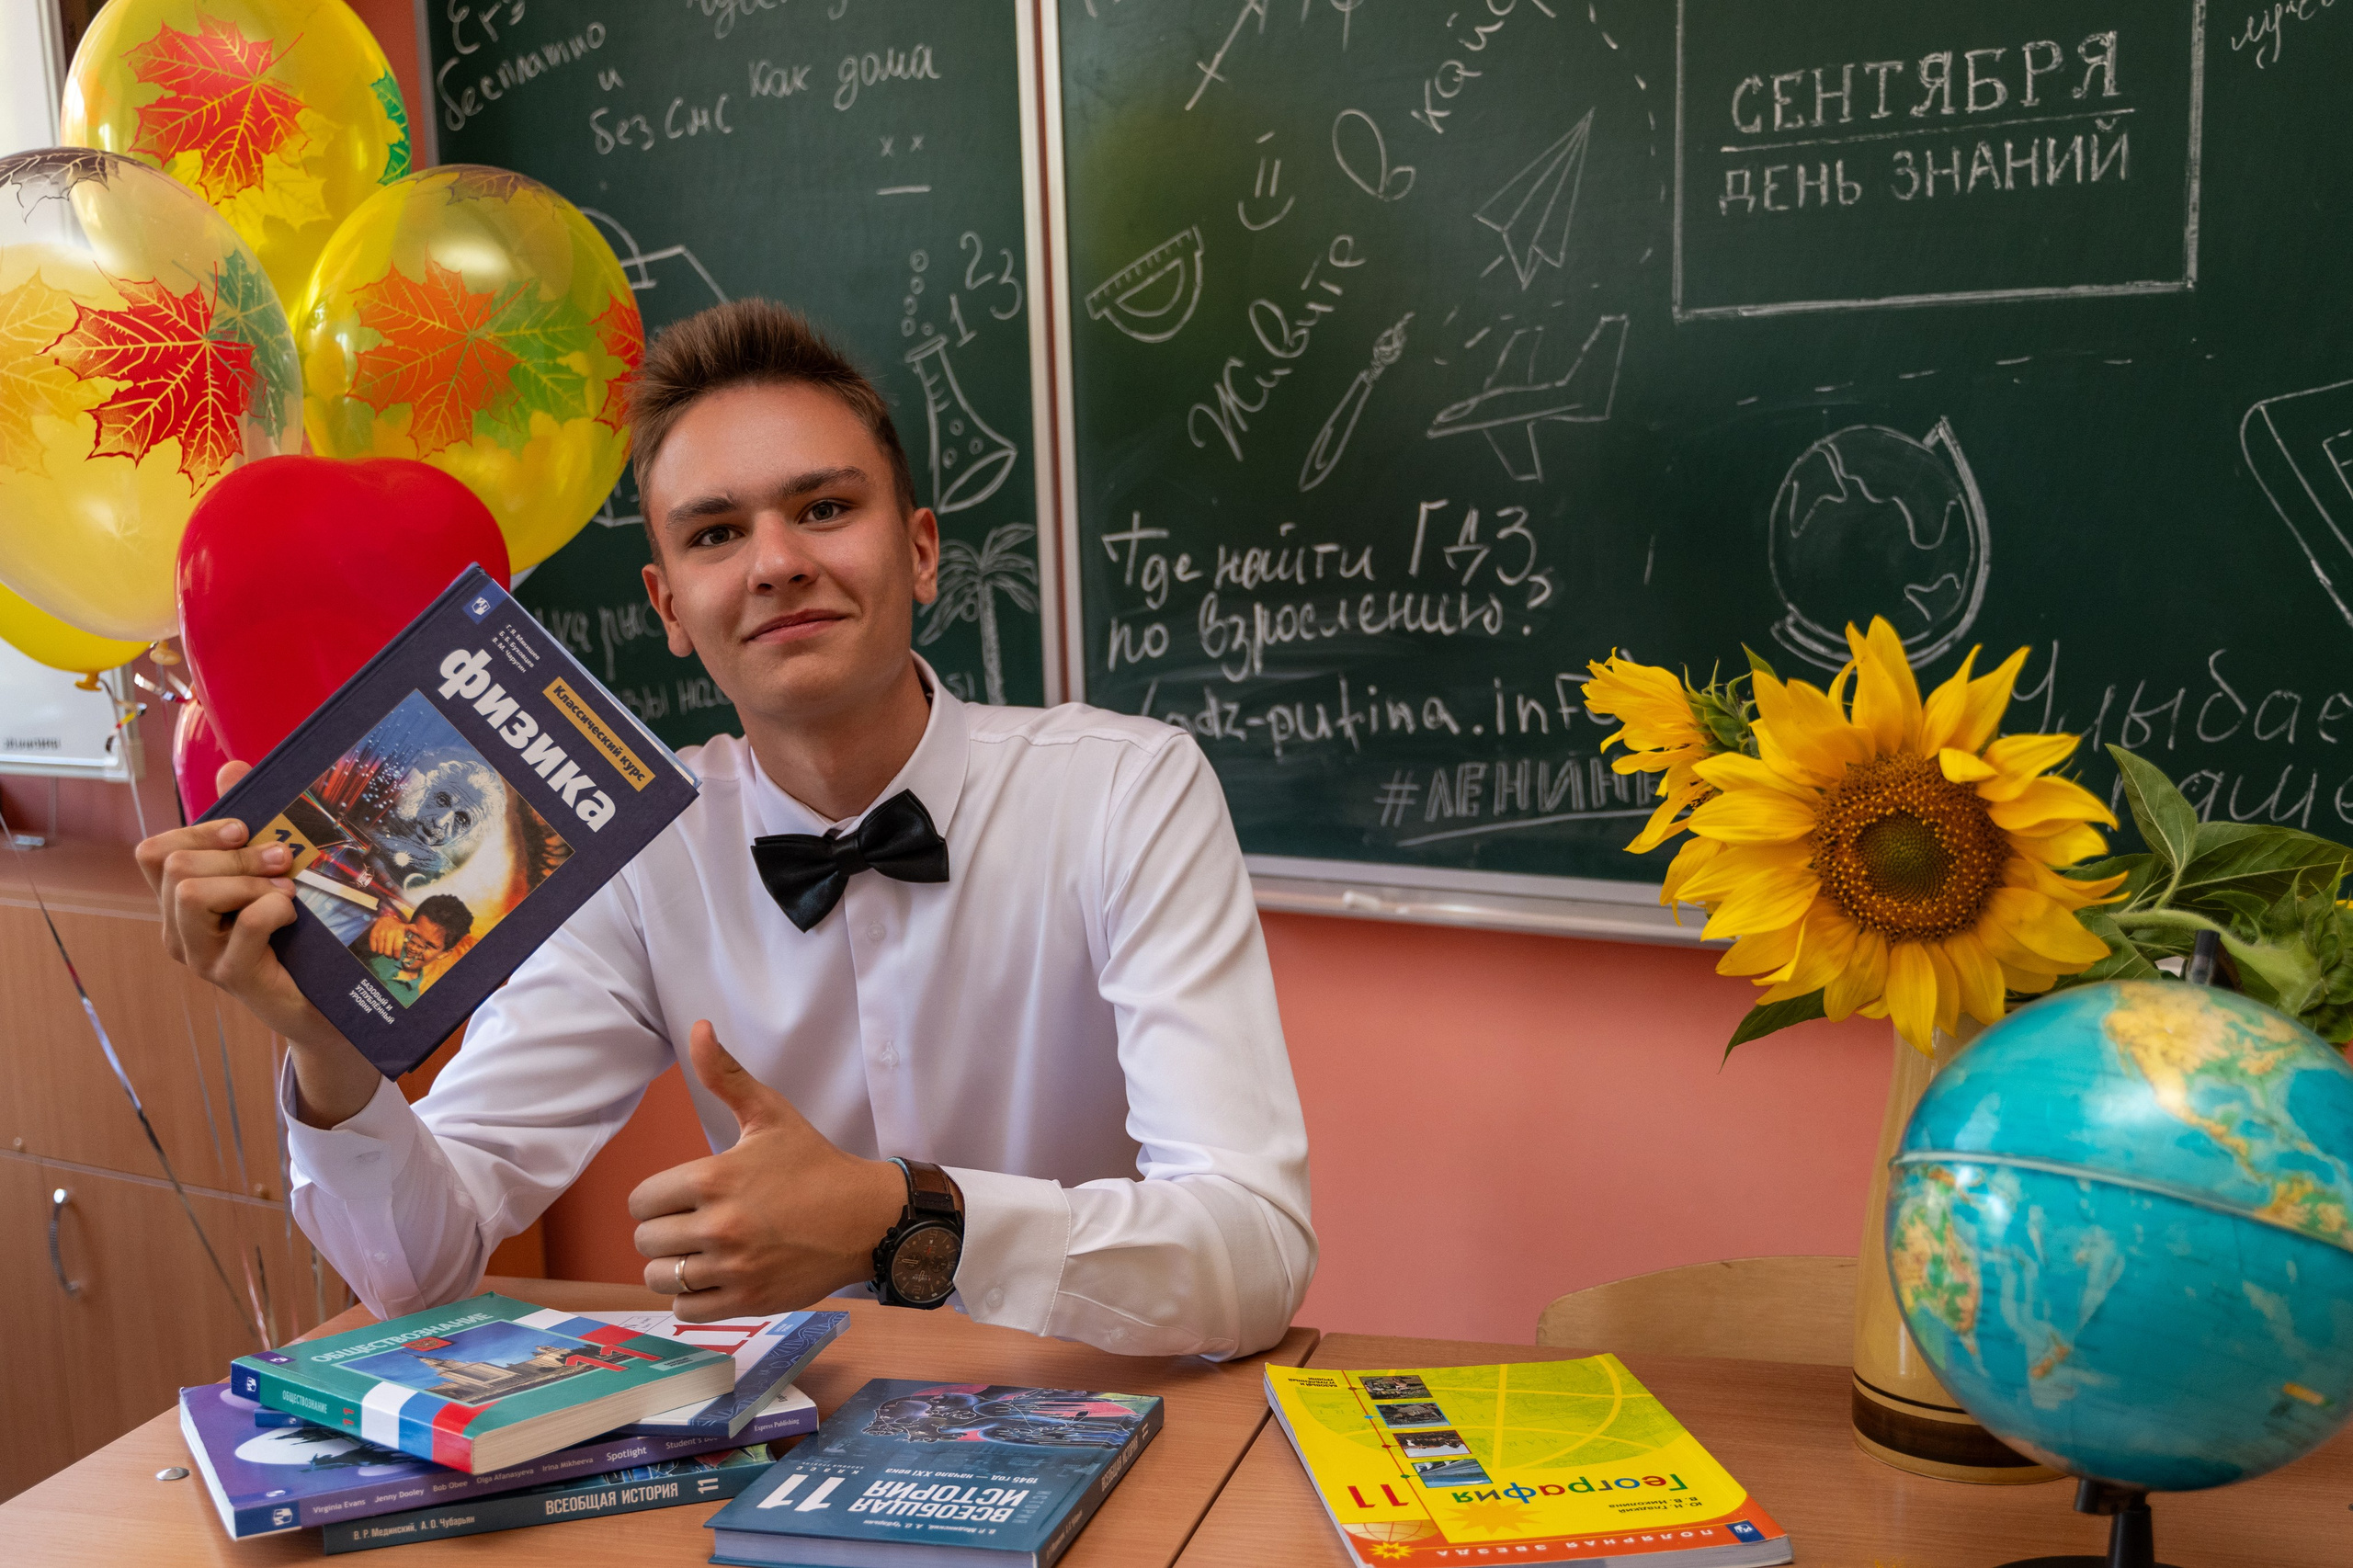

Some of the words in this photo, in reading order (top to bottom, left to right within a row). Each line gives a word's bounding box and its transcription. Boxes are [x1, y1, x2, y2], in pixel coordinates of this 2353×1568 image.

[597, 66, 625, 91] и
[834, 42, 942, 111] дома
[1731, 30, 2121, 134] СЕНТЯБРЯ
[589, 107, 655, 154] без
[1719, 158, 1864, 216] ДЕНЬ
[1891, 118, 2131, 201] ЗНАНИЙ
[1215, 522, 1376, 589] найти
[509, 642, 535, 668] Буховцев
[1108, 617, 1170, 671] по
[506, 649, 527, 673] Чаругин
[552, 685, 624, 758] Классический
[620, 753, 646, 782] курс
[349, 990, 373, 1014] УРОВНИ
[360, 978, 389, 1006] БАЗОВЫЙ
[311, 1312, 494, 1363] ОБЩЕСТВОЗНАНИЕ
[564, 1345, 664, 1372] 11
[281, 1390, 328, 1415] ОБЩЕСТВОЗНАНИЕ
[542, 1462, 559, 1472] Irina
[561, 1457, 594, 1470] Mikheeva
[607, 1447, 648, 1462] Spotlight
[433, 1483, 447, 1493] Bob
[449, 1480, 468, 1489] Obee
[476, 1475, 493, 1485] Olga
[494, 1468, 534, 1482] Afanasyeva
[935, 1471, 974, 1479] начало
[374, 1493, 397, 1504] Jenny
[399, 1487, 425, 1498] Dooley
[545, 1491, 617, 1516] ВСЕОБЩАЯ
[621, 1483, 678, 1505] ИСТОРИЯ
[698, 1477, 719, 1494] 11
[756, 1473, 846, 1512] 11
[862, 1480, 1030, 1507] ИСТОРИЯ
[1347, 1483, 1410, 1508] 11
[1451, 1473, 1688, 1504] География
[313, 1503, 342, 1514] Virginia
[344, 1498, 366, 1508] Evans
[847, 1497, 1015, 1523] ВСЕОБЩАЯ
[1608, 1499, 1667, 1508] Николина
[1619, 1504, 1668, 1514] Гладкий
[354, 1530, 361, 1540] В.
[363, 1529, 370, 1539] Р.
[371, 1522, 417, 1538] Мединский,
[421, 1520, 428, 1529] А.
[439, 1516, 475, 1528] Чубарьян
[1565, 1528, 1713, 1549] ПОЛЯРНАЯ
[1437, 1544, 1548, 1557] ЗВЕЗДА
